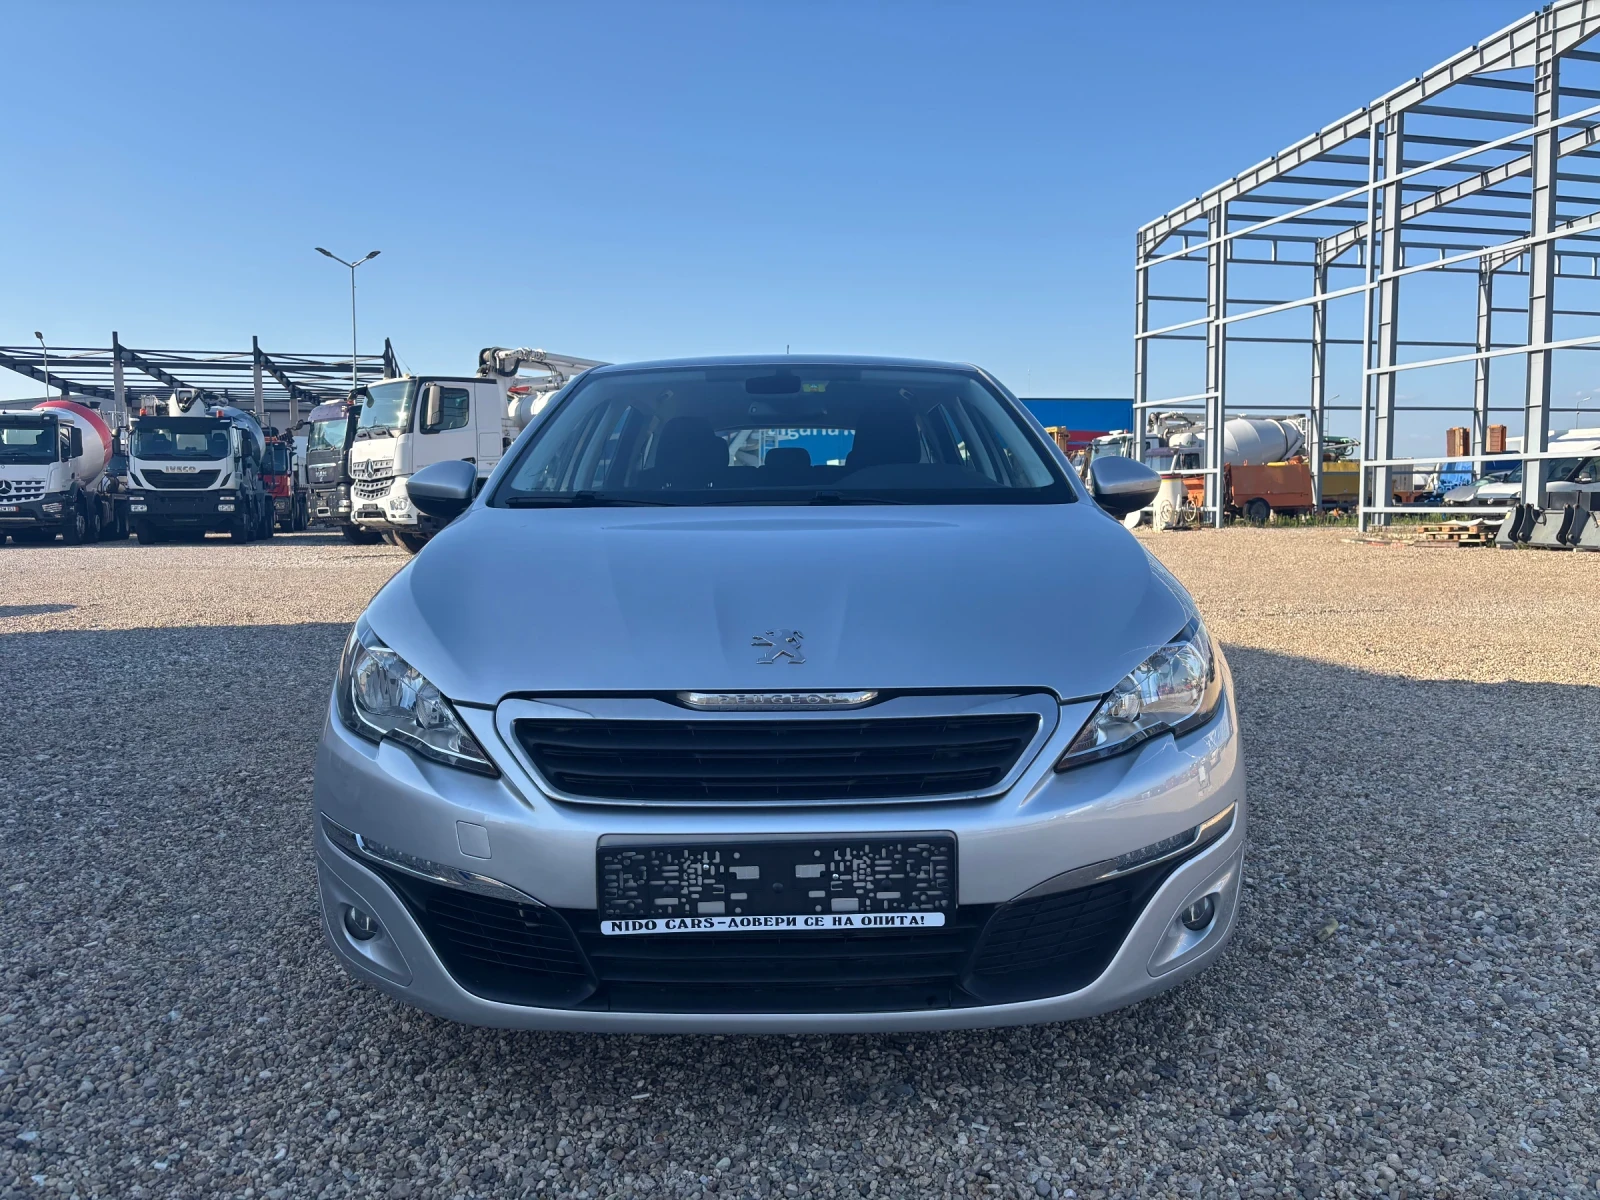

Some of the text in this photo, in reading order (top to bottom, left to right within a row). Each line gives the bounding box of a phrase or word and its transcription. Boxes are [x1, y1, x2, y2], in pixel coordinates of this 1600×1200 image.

[165, 465, 197, 473] IVECO
[718, 694, 837, 704] PEUGEOT
[611, 919, 658, 932] NIDO
[803, 916, 825, 927] СЕ
[832, 916, 854, 926] НА
[860, 915, 925, 926] ОПИТА!
